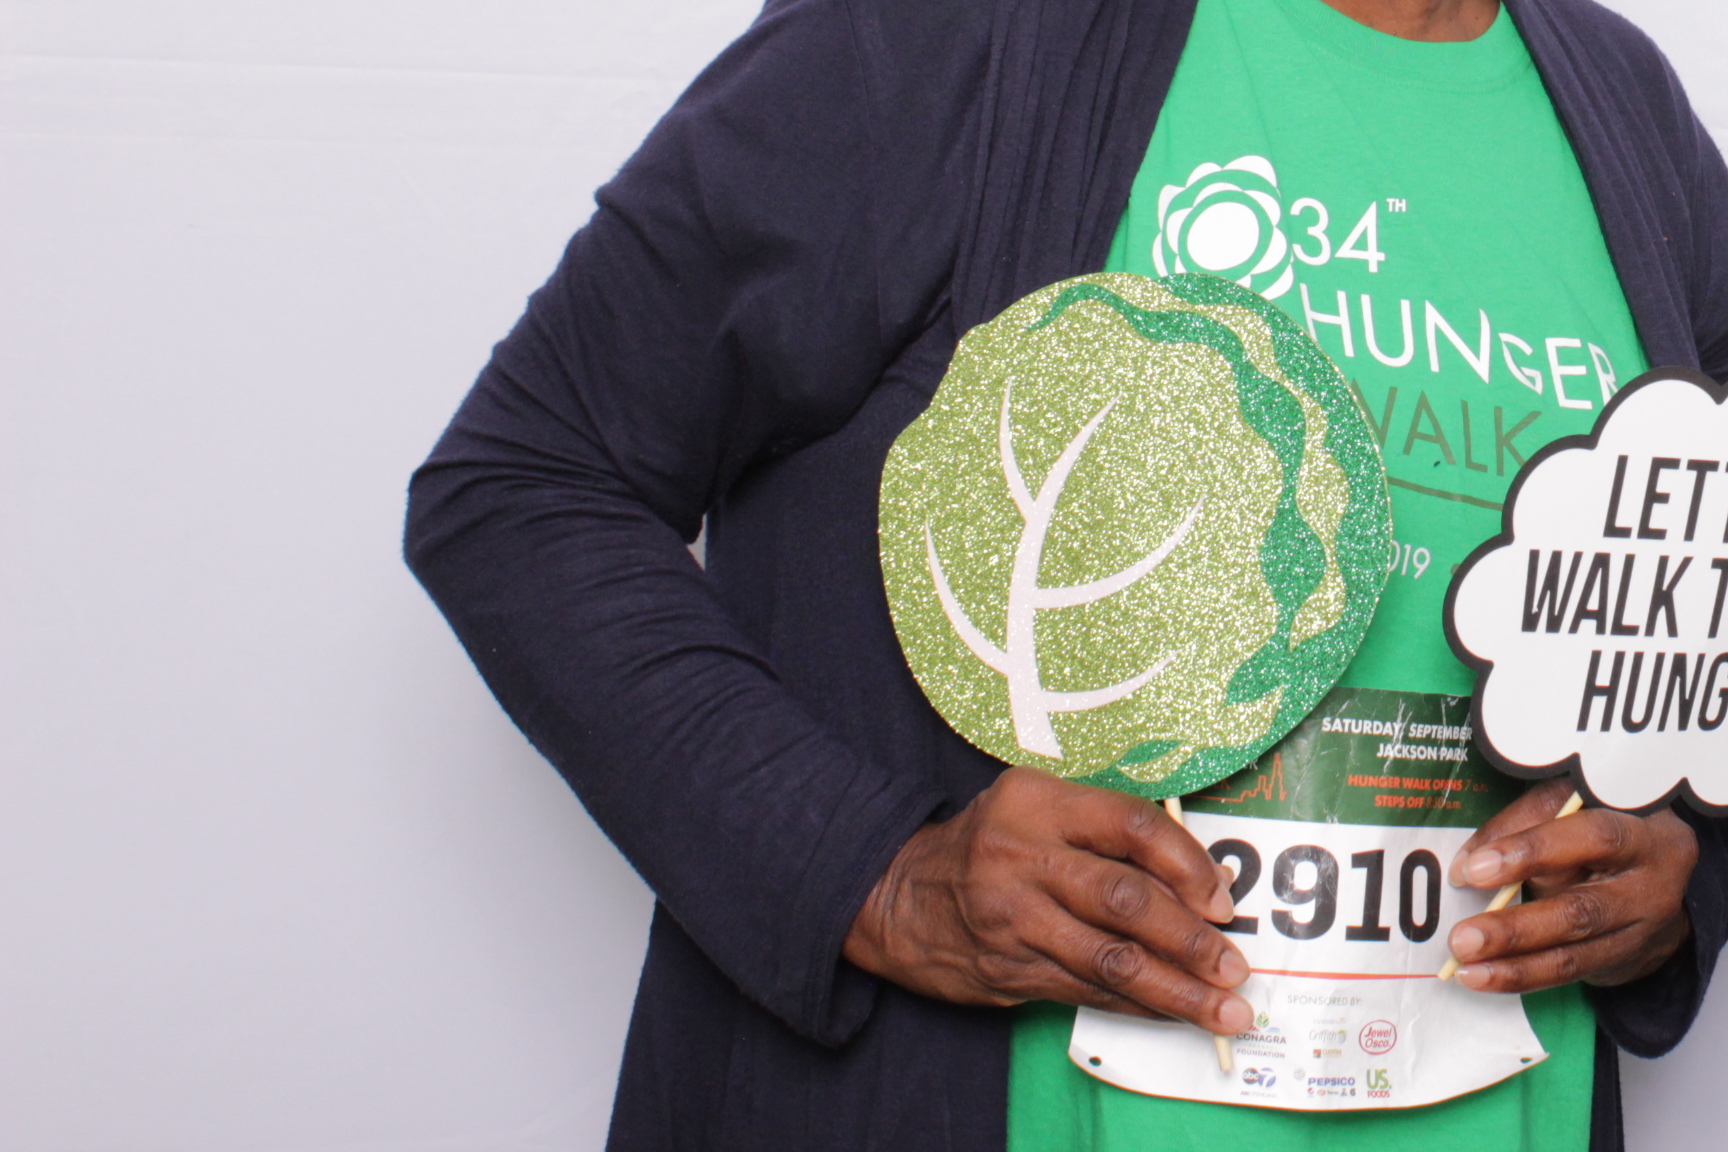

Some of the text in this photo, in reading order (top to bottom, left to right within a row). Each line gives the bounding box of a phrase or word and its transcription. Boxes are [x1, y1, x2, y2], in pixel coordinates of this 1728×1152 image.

[1299, 282, 1619, 410] HUNGER
[1388, 539, 1431, 580] 019
[1520, 548, 1694, 638] WALK
[1408, 723, 1473, 740] SEPTEMBER
[1376, 743, 1469, 761] JACKSON PARK
[1347, 775, 1400, 789] HUNGER
[1402, 778, 1431, 791] WALK
[1433, 779, 1463, 791] OPENS
[1374, 795, 1405, 808] STEPS
[1406, 796, 1425, 808] OFF
[1206, 837, 1442, 943] 2910
[1287, 994, 1348, 1006] SPONSORED
[1236, 1032, 1287, 1045] CONAGRA
[1364, 1026, 1392, 1038] Jewel
[1236, 1048, 1286, 1059] FOUNDATION
[1308, 1077, 1356, 1086] PEPSICO
[1367, 1090, 1391, 1098] FOODS
